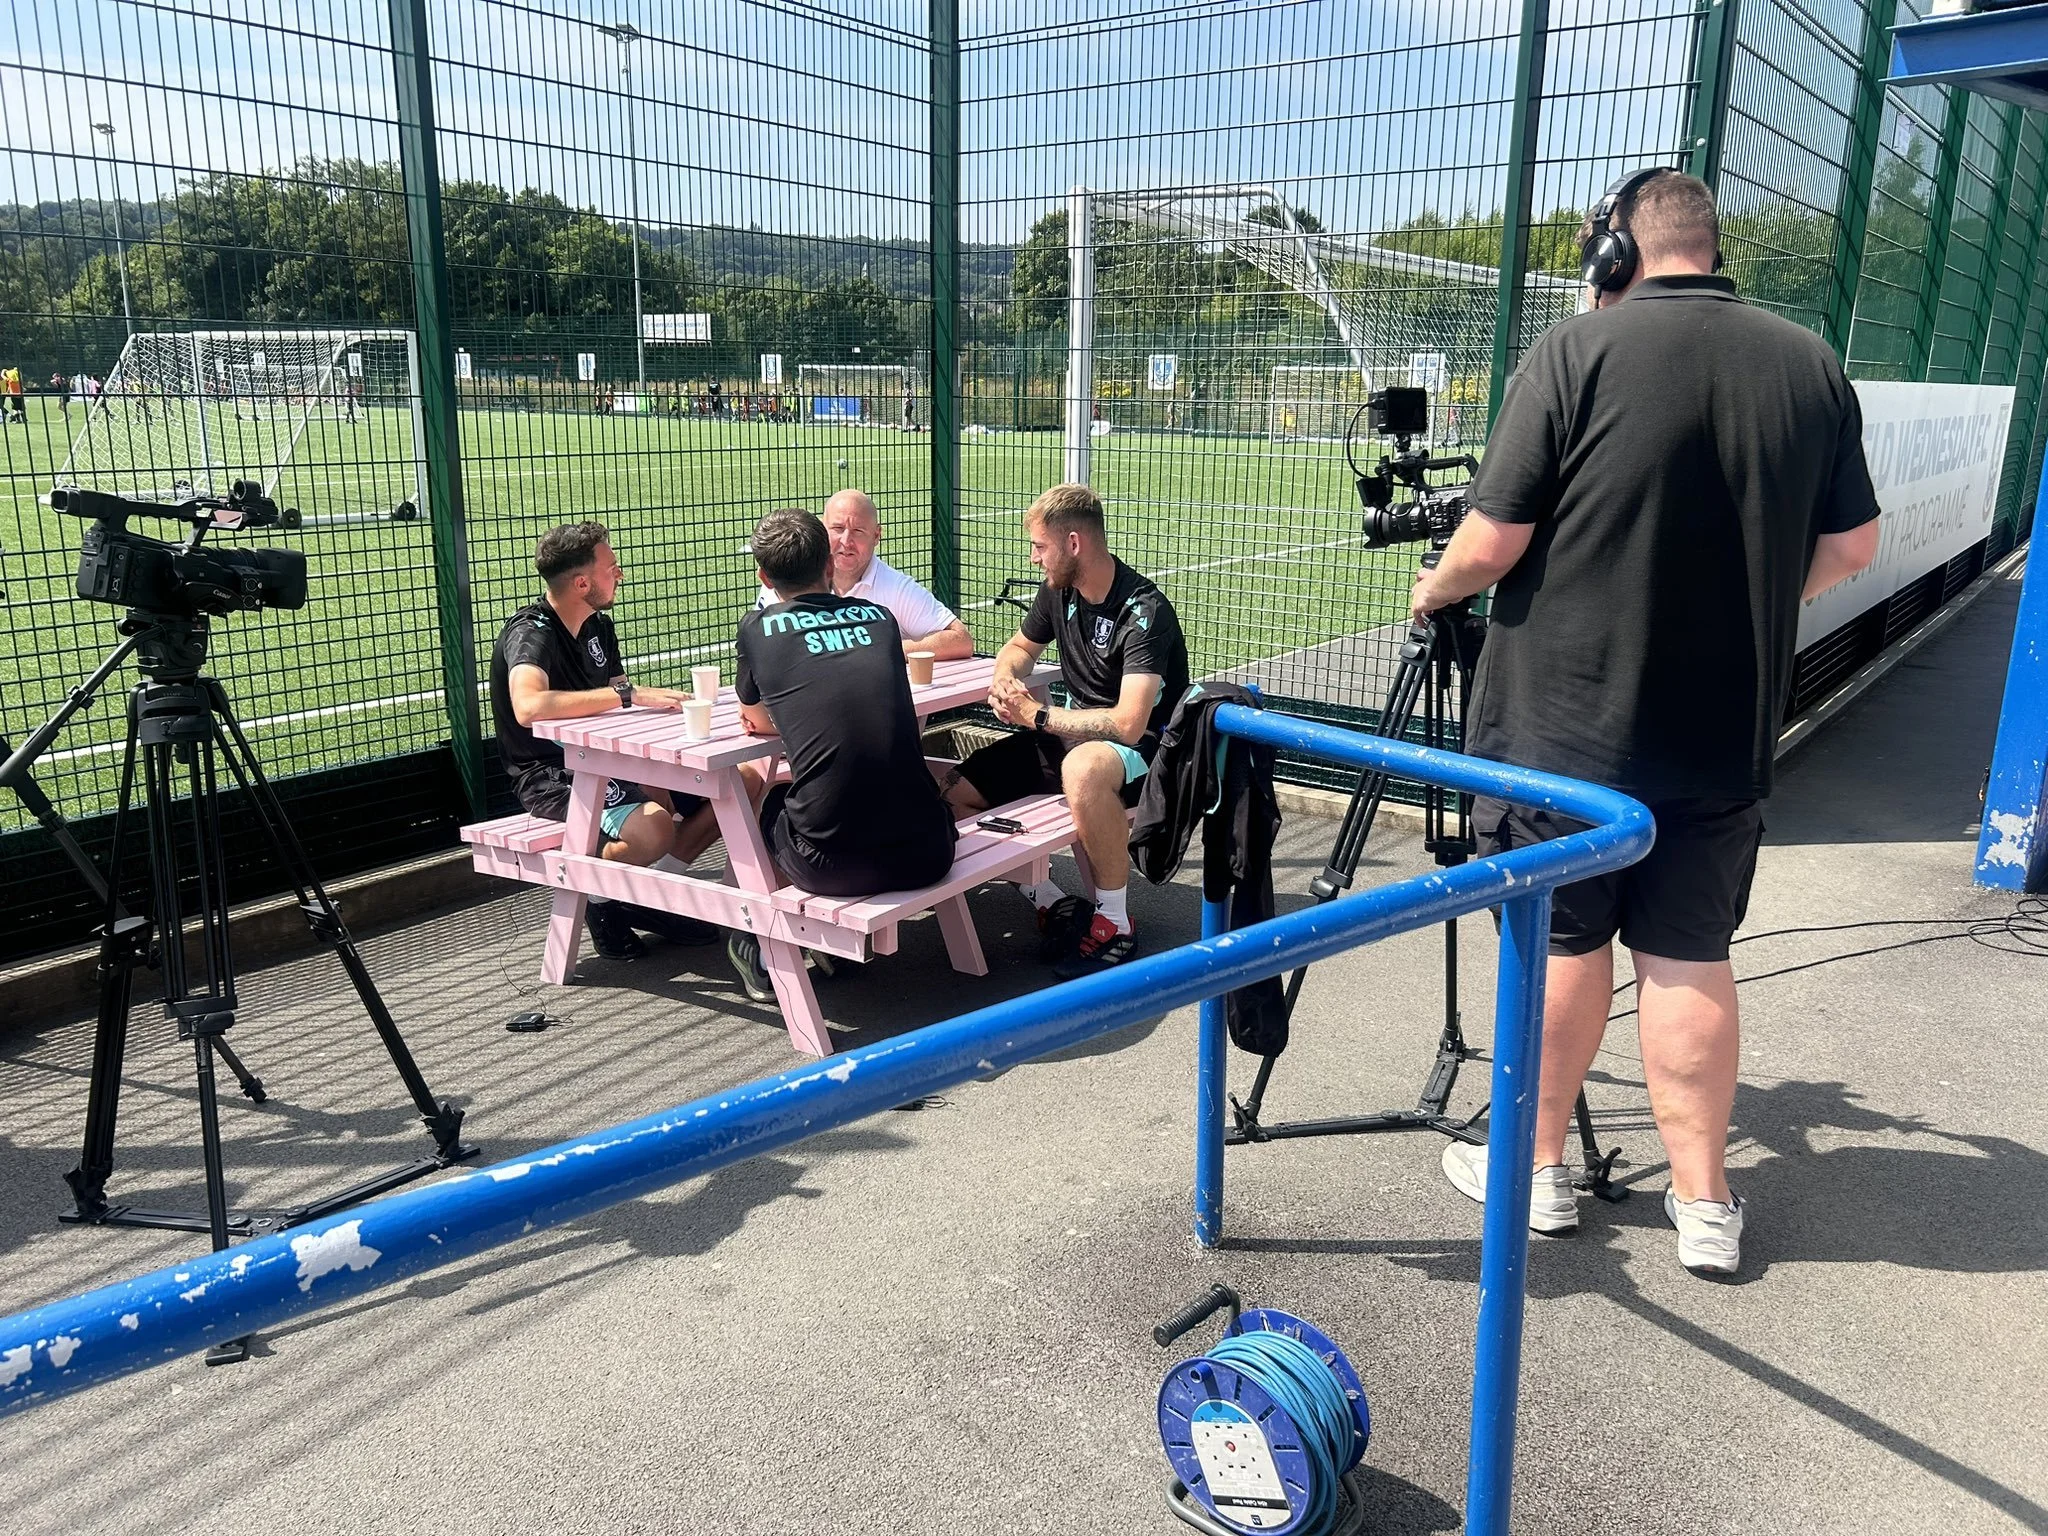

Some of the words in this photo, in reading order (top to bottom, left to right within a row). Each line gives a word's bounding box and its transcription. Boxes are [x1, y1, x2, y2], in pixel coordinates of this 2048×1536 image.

[1894, 414, 1979, 487] WEDNESDAY
[1898, 485, 1970, 557] PROGRAMME
[762, 605, 886, 637] macron
[804, 626, 872, 654] SWFC
